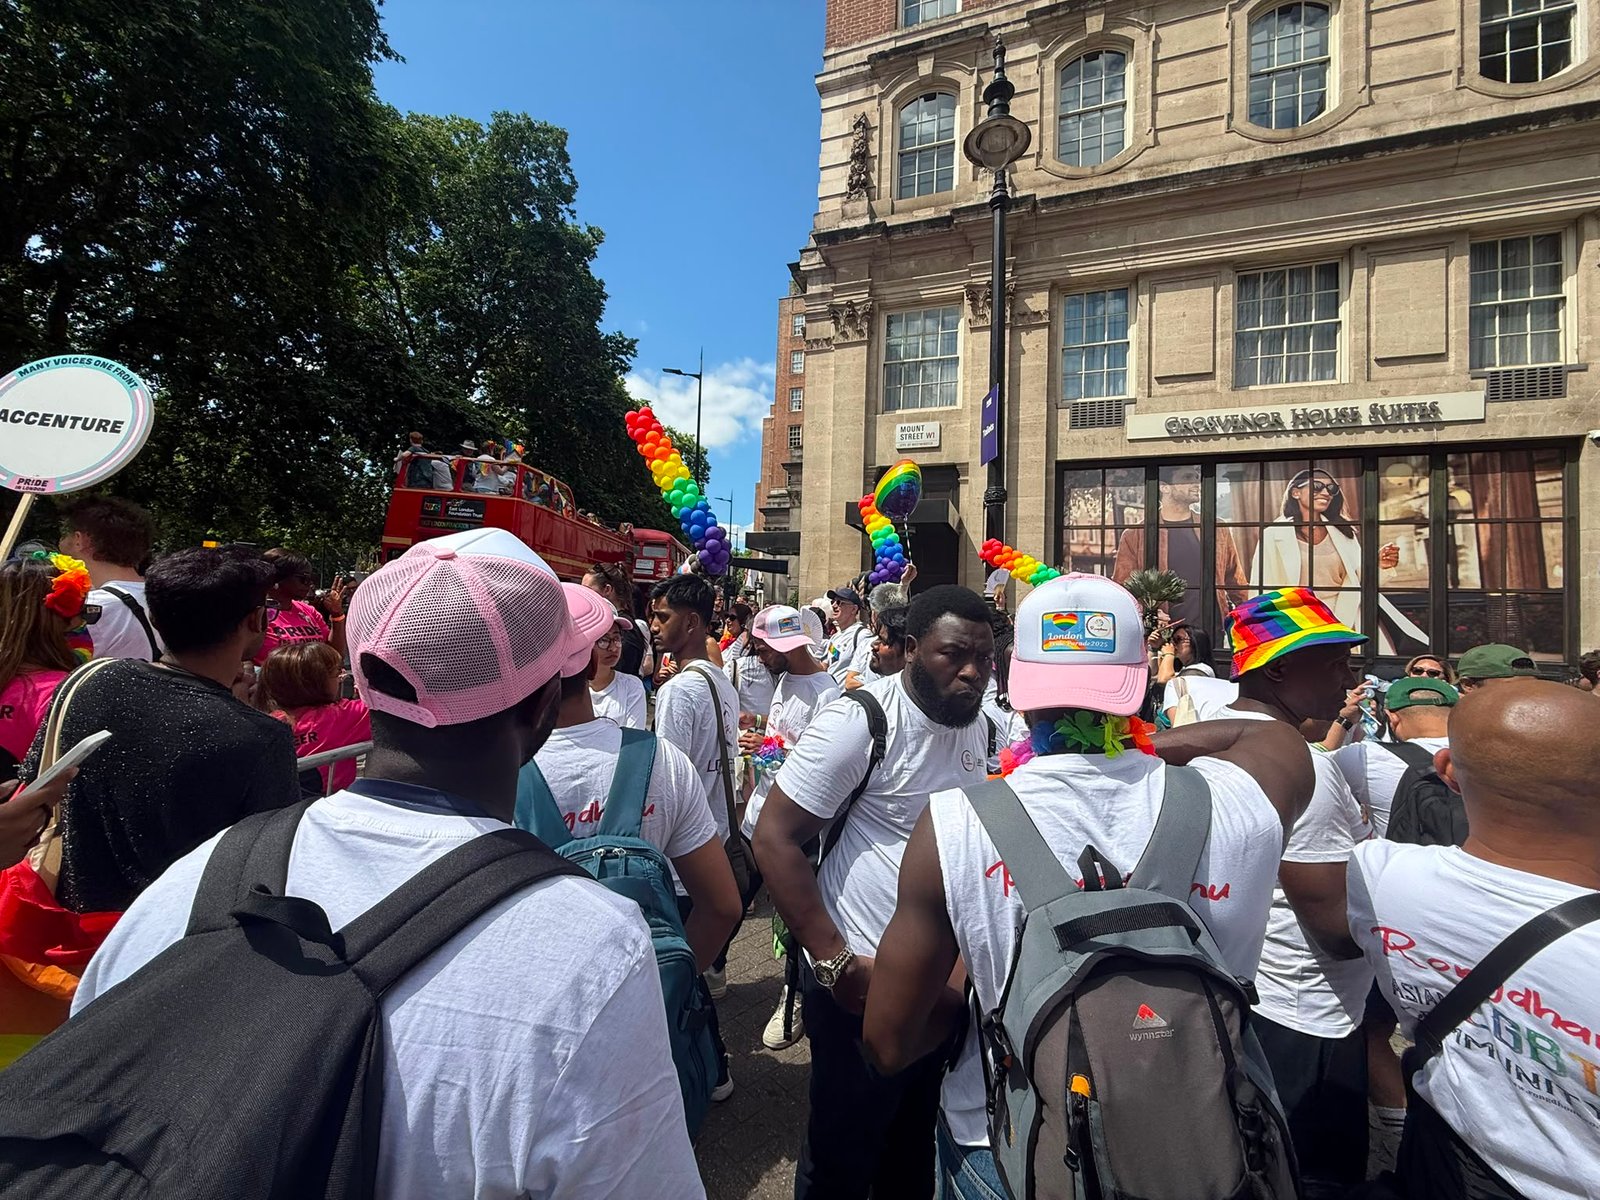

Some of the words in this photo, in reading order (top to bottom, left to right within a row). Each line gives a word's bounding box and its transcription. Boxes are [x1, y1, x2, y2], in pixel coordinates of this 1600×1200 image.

[18, 360, 52, 377] MANY
[53, 357, 93, 366] VOICES
[94, 359, 114, 371] ONE
[112, 367, 138, 389] FRONT
[0, 408, 125, 434] ACCENTURE
[1164, 411, 1286, 432] GROSVENOR
[1290, 406, 1360, 425] HOUSE
[1369, 400, 1440, 420] SUITES
[900, 424, 925, 433] MOUNT
[900, 432, 923, 441] STREET
[1047, 631, 1084, 641] London
